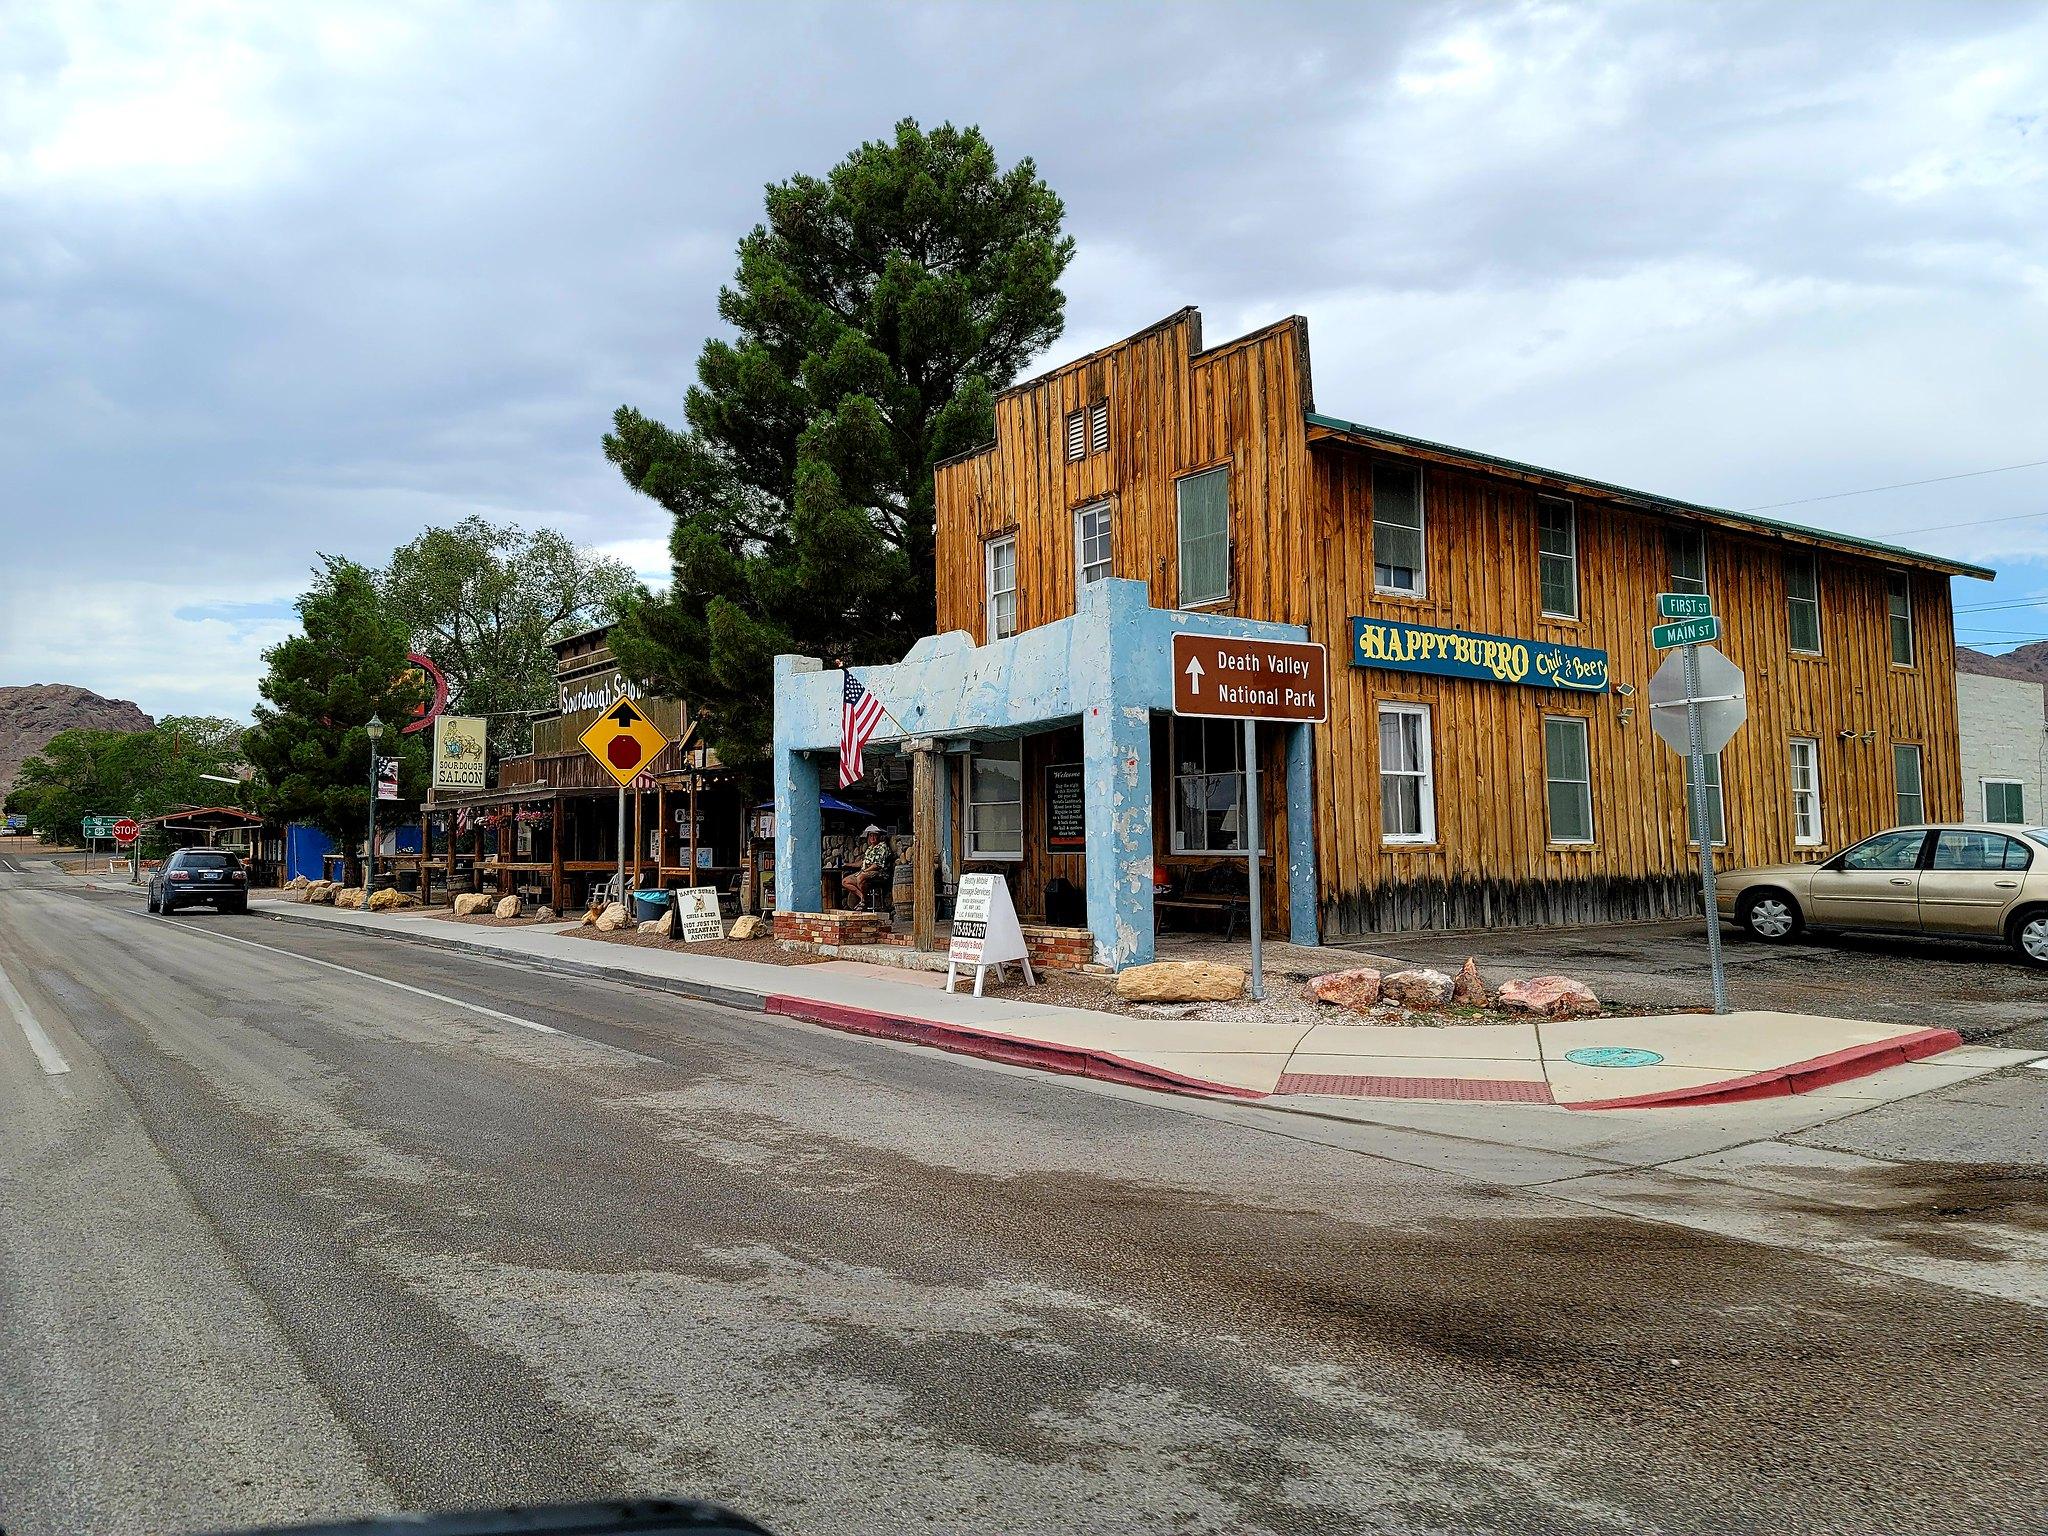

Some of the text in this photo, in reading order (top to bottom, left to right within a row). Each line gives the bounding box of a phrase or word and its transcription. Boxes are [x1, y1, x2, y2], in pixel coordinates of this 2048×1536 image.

[1671, 599, 1707, 613] FIRST ST
[1667, 625, 1710, 642] MAIN ST
[1360, 625, 1529, 682] HAPPY BURRO
[1218, 651, 1309, 679] Death Valley
[1536, 648, 1563, 675] Chili
[1572, 656, 1603, 680] Beer
[562, 680, 612, 717] Sourdough
[1219, 684, 1316, 708] National Park
[440, 761, 483, 771] SOURDOUGH
[440, 771, 483, 784] SALOON
[115, 826, 137, 835] STOP
[764, 859, 775, 870] OP
